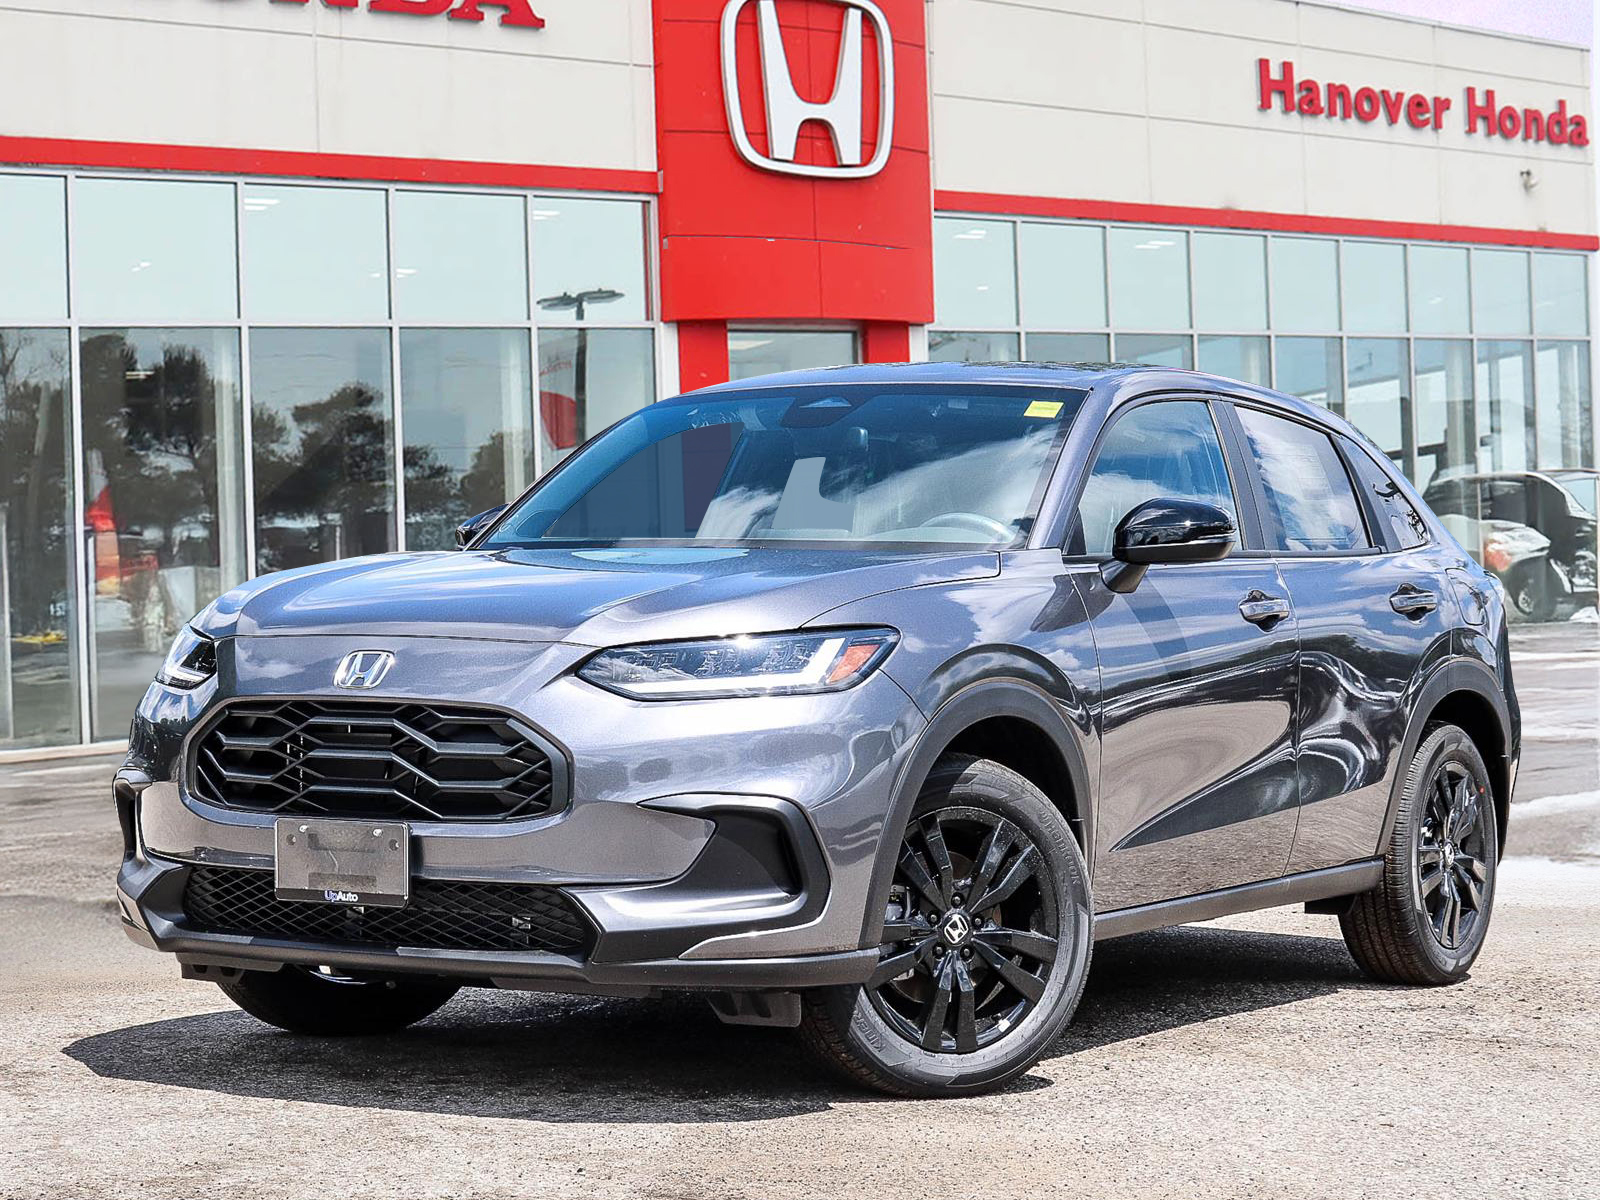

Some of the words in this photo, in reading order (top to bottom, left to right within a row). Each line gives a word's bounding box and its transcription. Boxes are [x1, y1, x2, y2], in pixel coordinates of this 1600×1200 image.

[1257, 57, 1452, 129] Hanover
[1465, 86, 1590, 146] Honda
[324, 890, 359, 902] UpAuto
